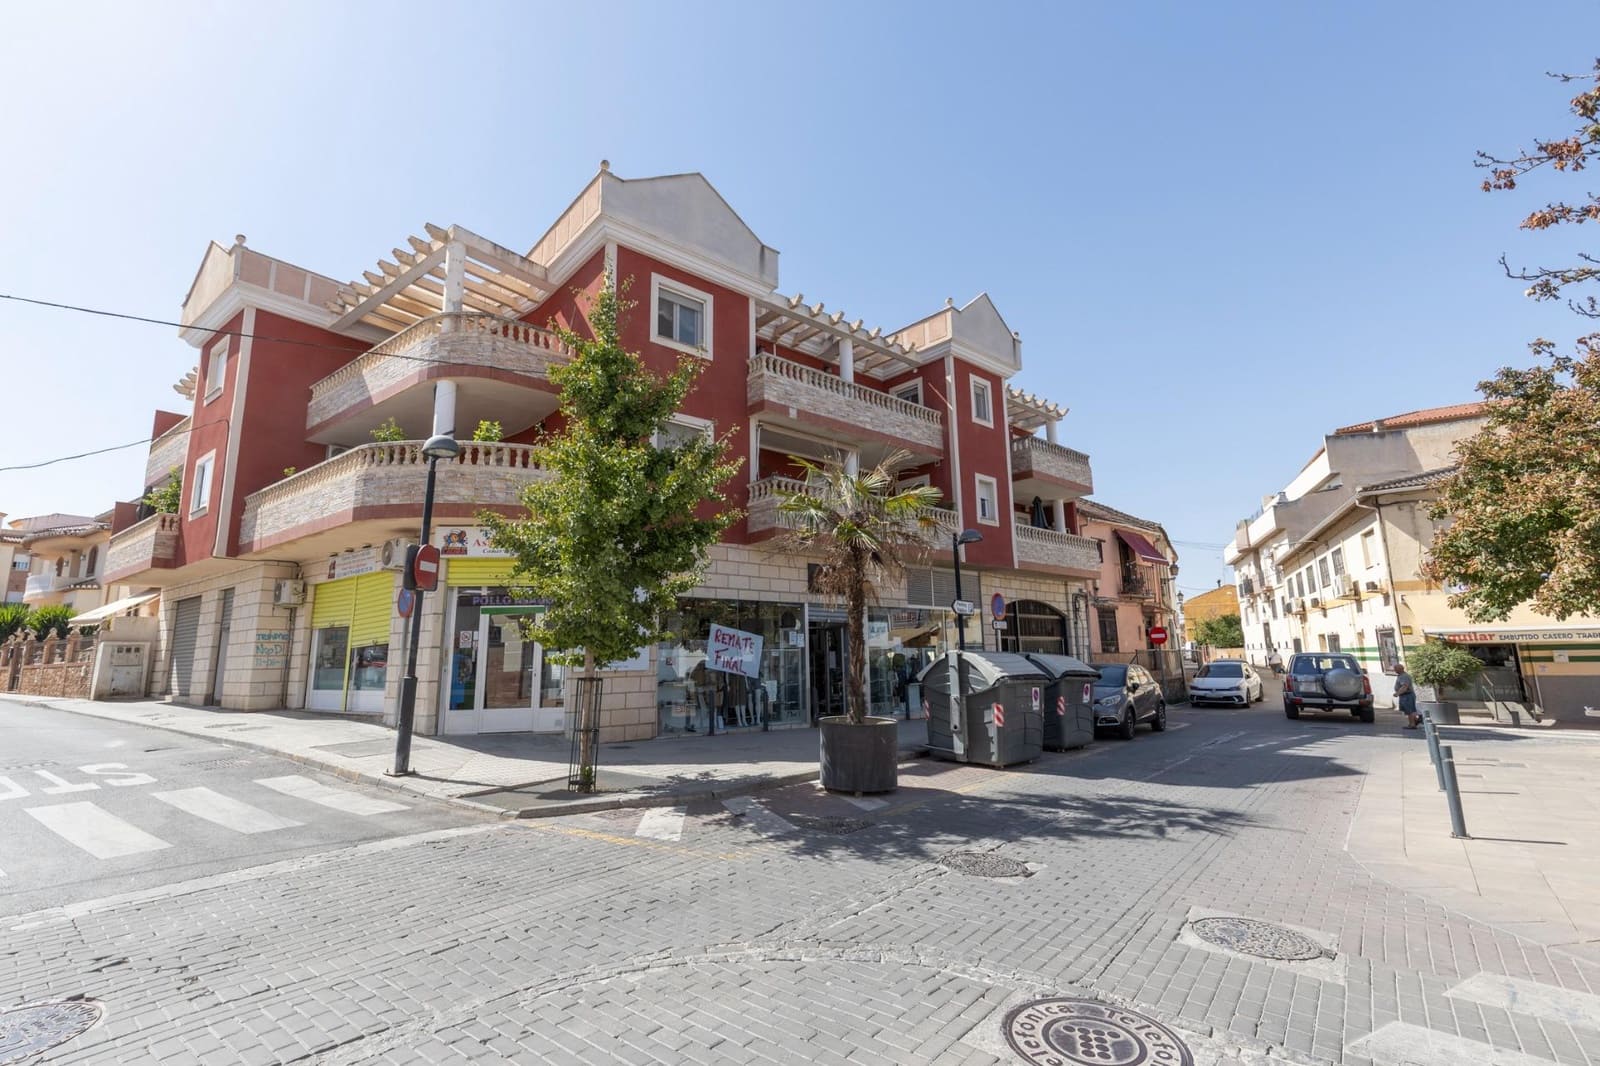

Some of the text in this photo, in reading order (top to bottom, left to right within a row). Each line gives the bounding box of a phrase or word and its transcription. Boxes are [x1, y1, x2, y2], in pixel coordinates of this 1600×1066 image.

[472, 596, 511, 605] POLLO
[714, 628, 755, 650] REMATE
[1498, 633, 1539, 641] EMBUTIDO
[1542, 632, 1573, 640] CASERO
[714, 648, 747, 674] FINAL
[1014, 1003, 1179, 1066] elefónica Telefó
